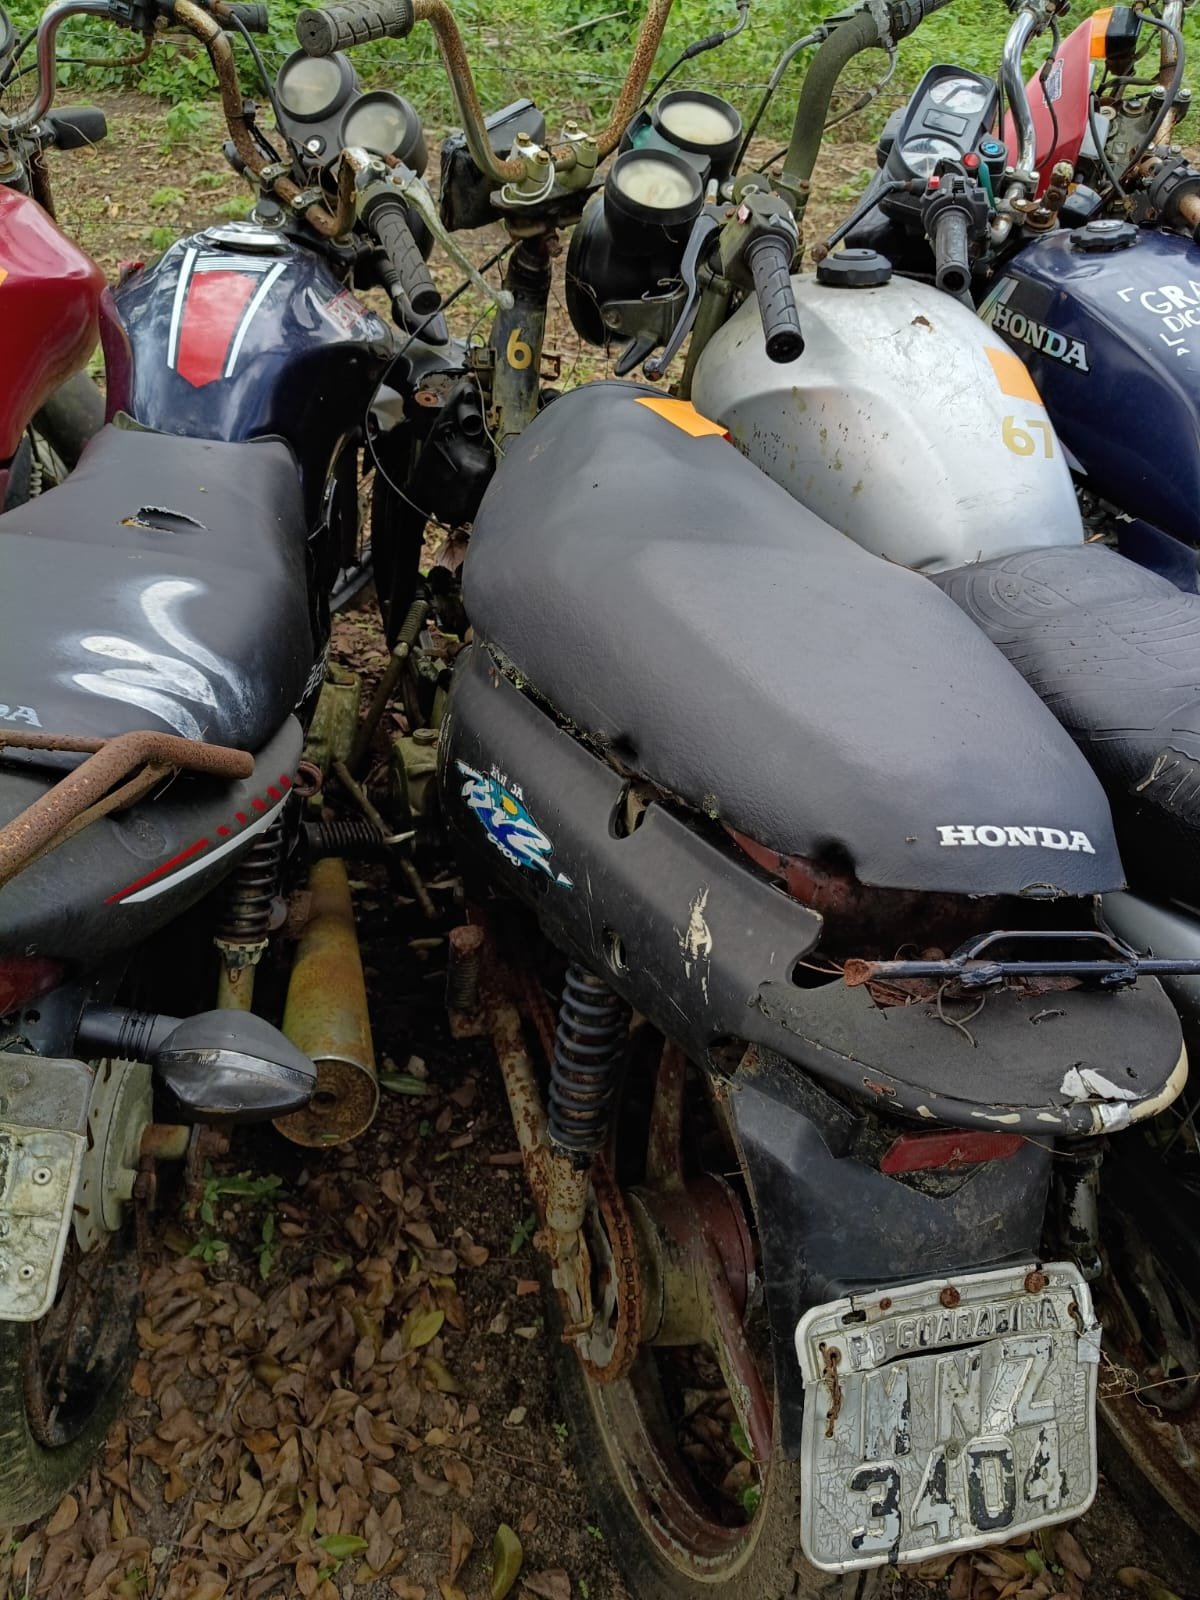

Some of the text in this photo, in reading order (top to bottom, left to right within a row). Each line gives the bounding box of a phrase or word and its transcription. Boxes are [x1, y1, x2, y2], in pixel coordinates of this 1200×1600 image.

[507, 327, 532, 369] 6
[993, 302, 1090, 372] HONDA
[1002, 416, 1054, 459] 67
[936, 825, 1096, 854] HONDA
[861, 1333, 1056, 1461] MNZ
[850, 1422, 1070, 1550] 3404
